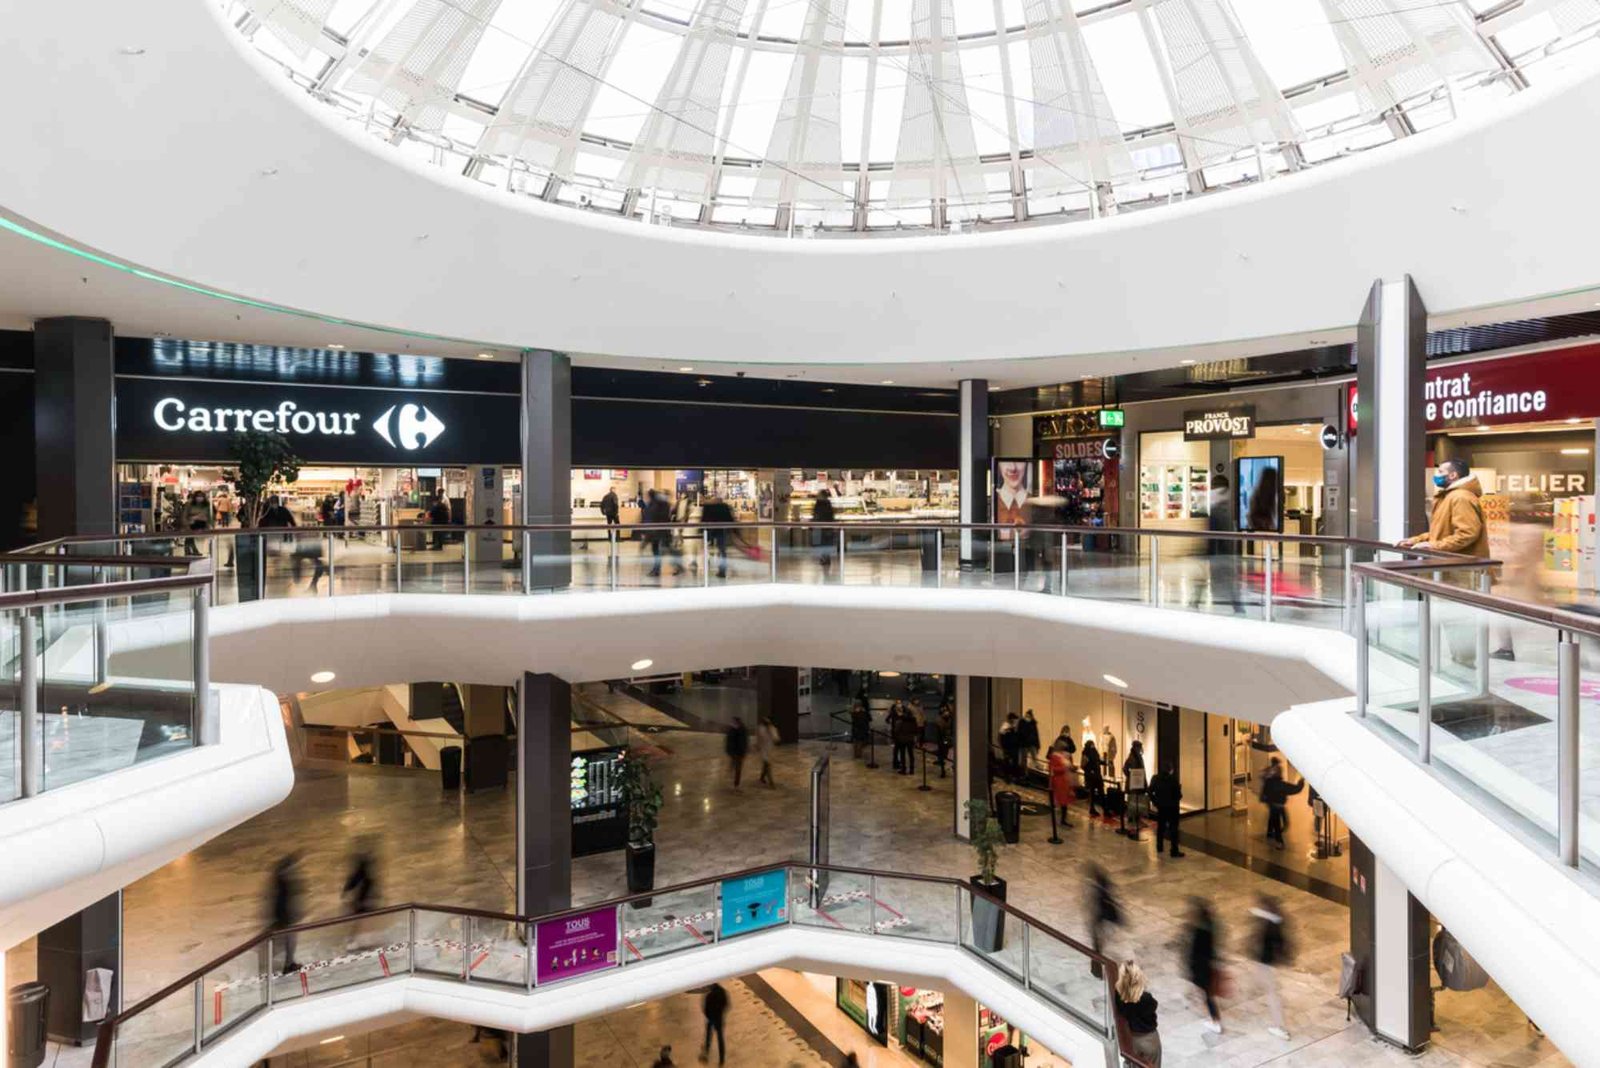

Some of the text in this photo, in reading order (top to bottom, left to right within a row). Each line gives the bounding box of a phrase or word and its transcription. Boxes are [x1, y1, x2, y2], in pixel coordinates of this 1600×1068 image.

[1425, 372, 1471, 400] ntrat
[153, 397, 361, 435] Carrefour
[1425, 390, 1547, 421] e confiance
[1186, 416, 1251, 434] PROVOST
[1055, 441, 1103, 459] SOLDES
[1496, 474, 1586, 492] TELIER
